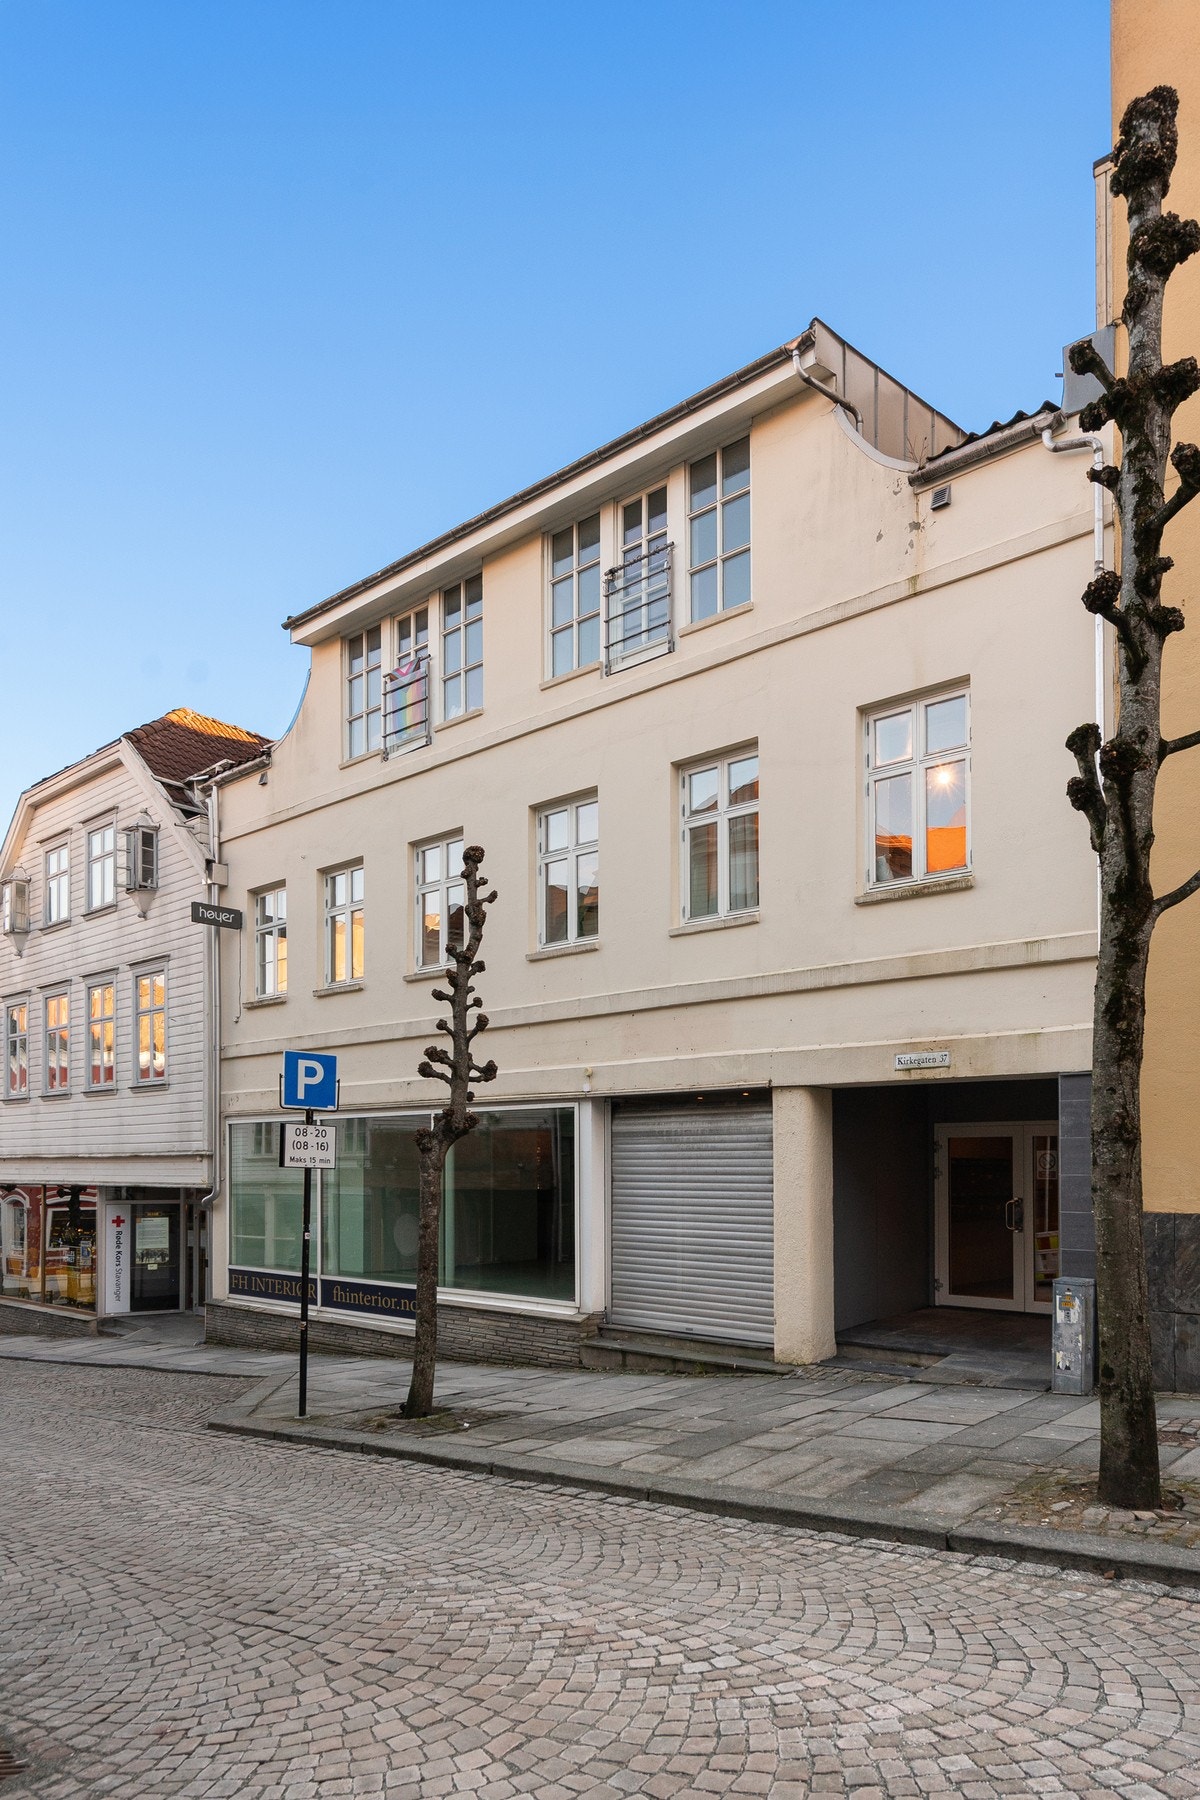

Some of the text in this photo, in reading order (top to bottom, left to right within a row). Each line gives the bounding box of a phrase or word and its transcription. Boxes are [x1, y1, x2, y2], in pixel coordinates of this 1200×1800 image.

[199, 906, 235, 923] høyer
[897, 1053, 948, 1068] Kirkegaten 37
[297, 1059, 325, 1100] P
[289, 1155, 307, 1164] Maks
[309, 1156, 317, 1164] 15
[113, 1230, 123, 1302] Røde Kors Stavanger
[231, 1274, 249, 1290] FH
